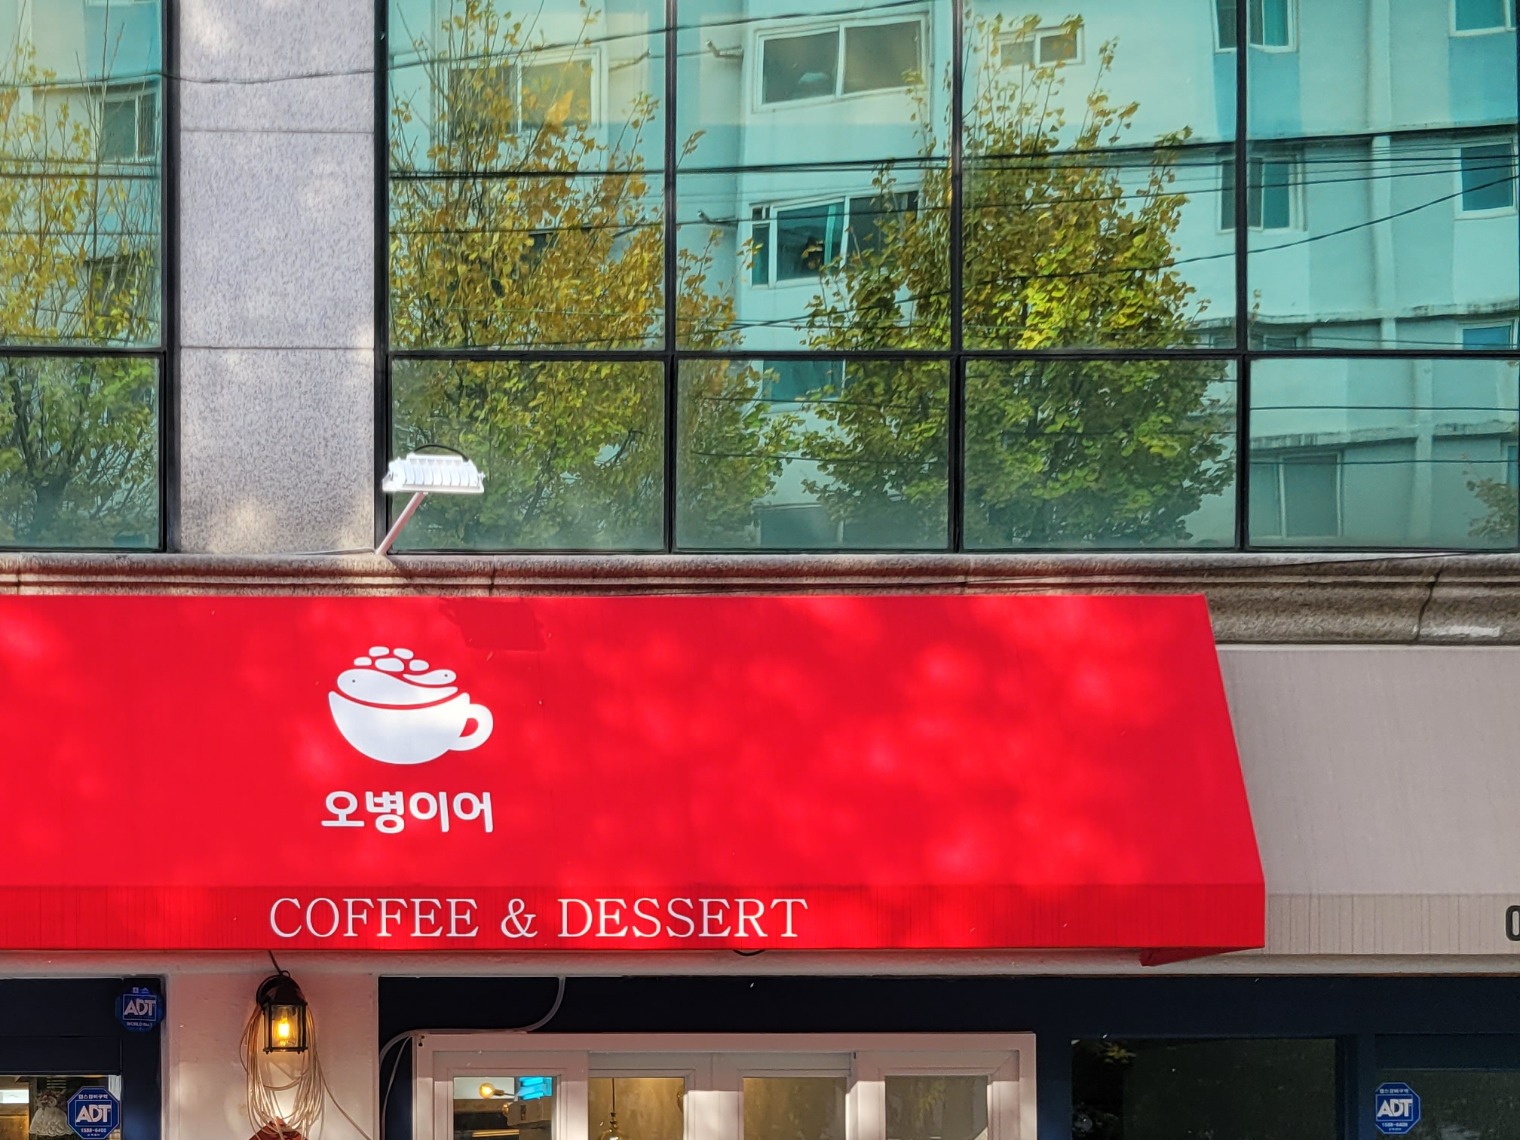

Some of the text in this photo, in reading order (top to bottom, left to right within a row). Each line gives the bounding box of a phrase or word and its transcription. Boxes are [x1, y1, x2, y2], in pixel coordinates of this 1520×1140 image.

[321, 790, 494, 834] 오병이어
[269, 897, 808, 939] COFFEE & DESSERT
[124, 998, 157, 1016] ADT
[75, 1104, 112, 1123] ADT
[1376, 1098, 1413, 1117] ADT
